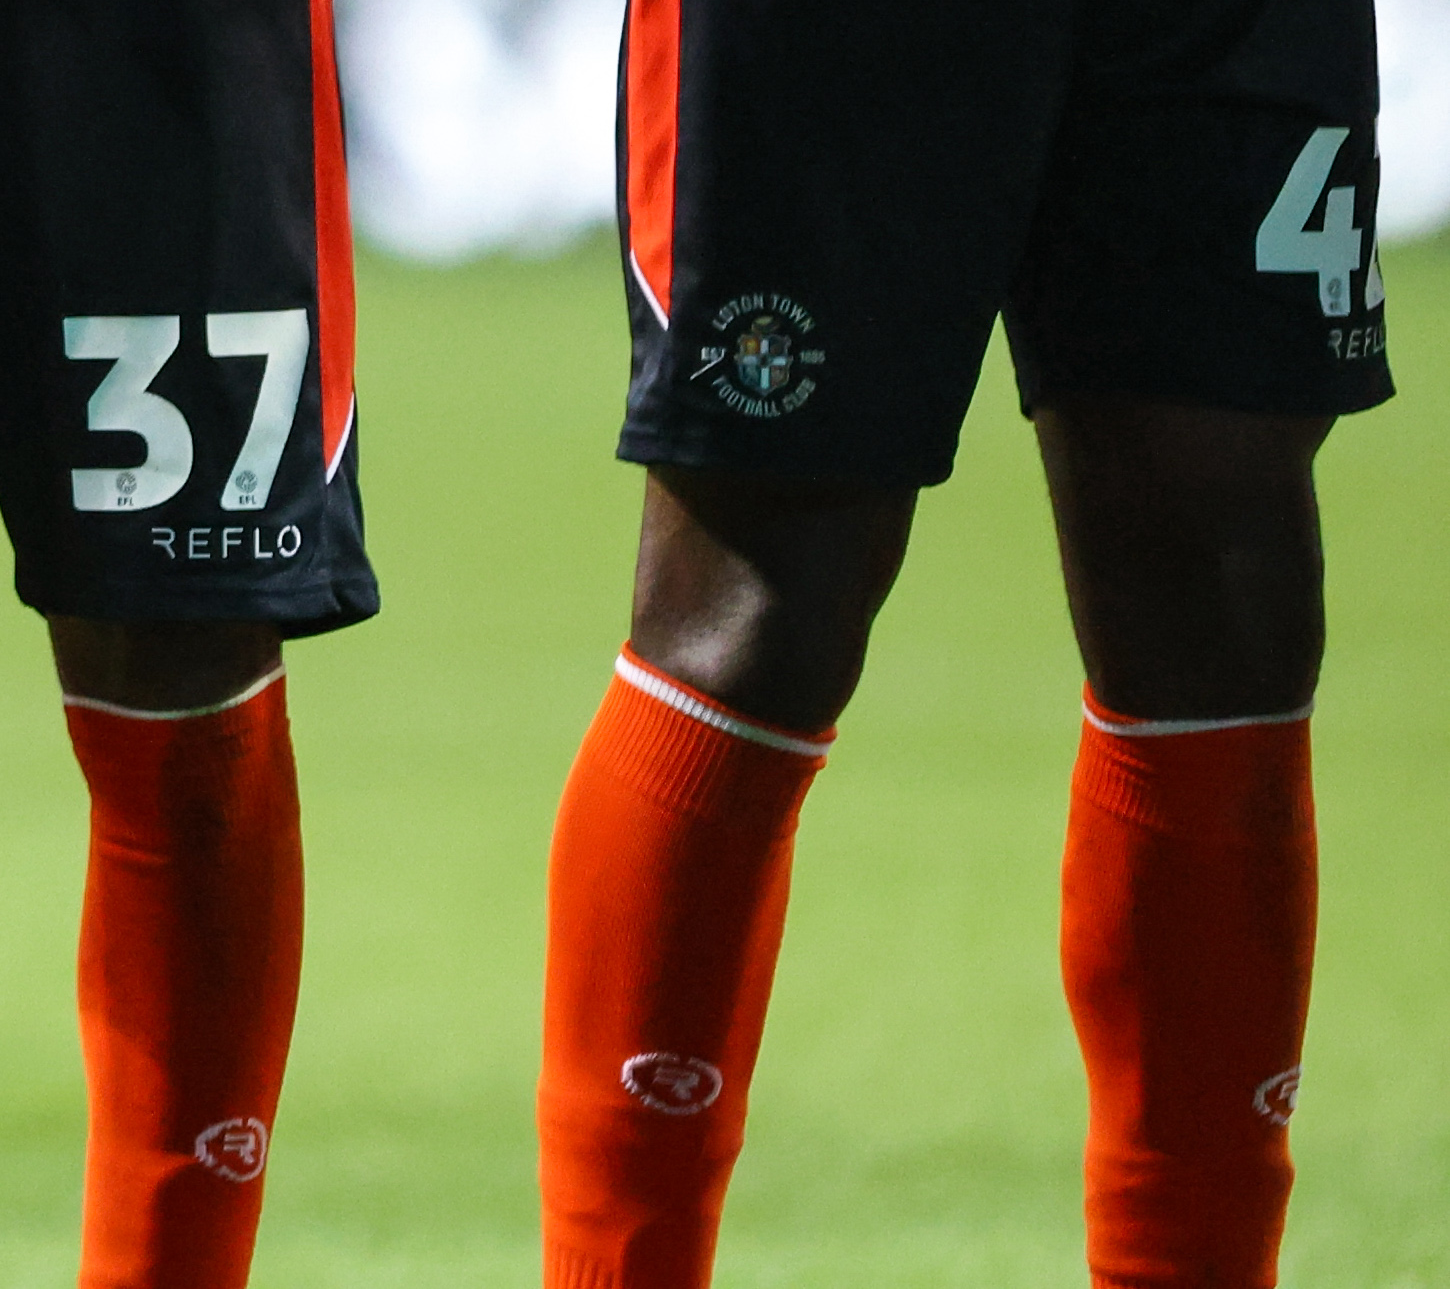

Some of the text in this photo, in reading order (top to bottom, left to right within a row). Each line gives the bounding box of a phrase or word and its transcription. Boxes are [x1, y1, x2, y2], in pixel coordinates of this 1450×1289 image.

[1255, 118, 1386, 318] 4
[63, 308, 310, 512] 37
[151, 524, 302, 560] REFLO
